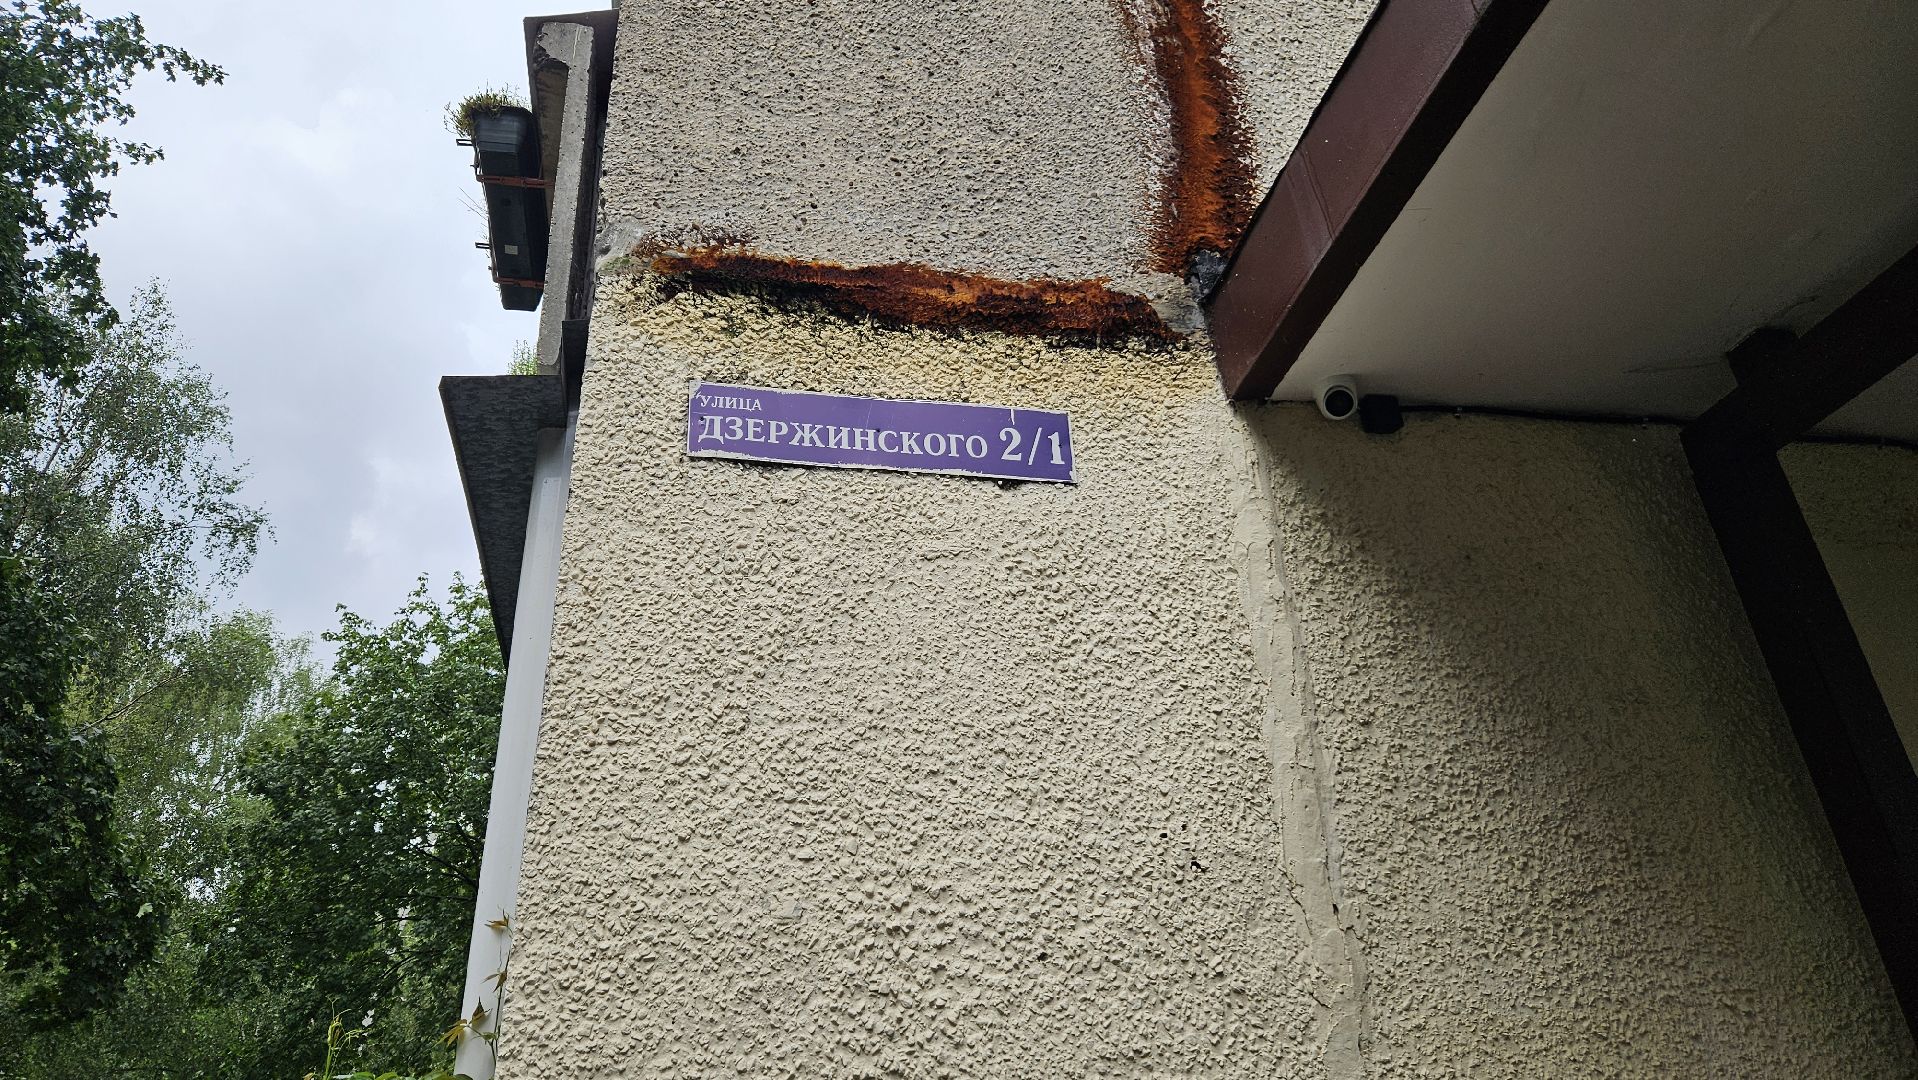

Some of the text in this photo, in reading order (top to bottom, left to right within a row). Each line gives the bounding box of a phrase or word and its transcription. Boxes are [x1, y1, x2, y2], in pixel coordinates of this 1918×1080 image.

[700, 395, 762, 411] УЛИЦА
[698, 415, 1065, 465] ДЗЕРЖИНСКОГО 2/1
